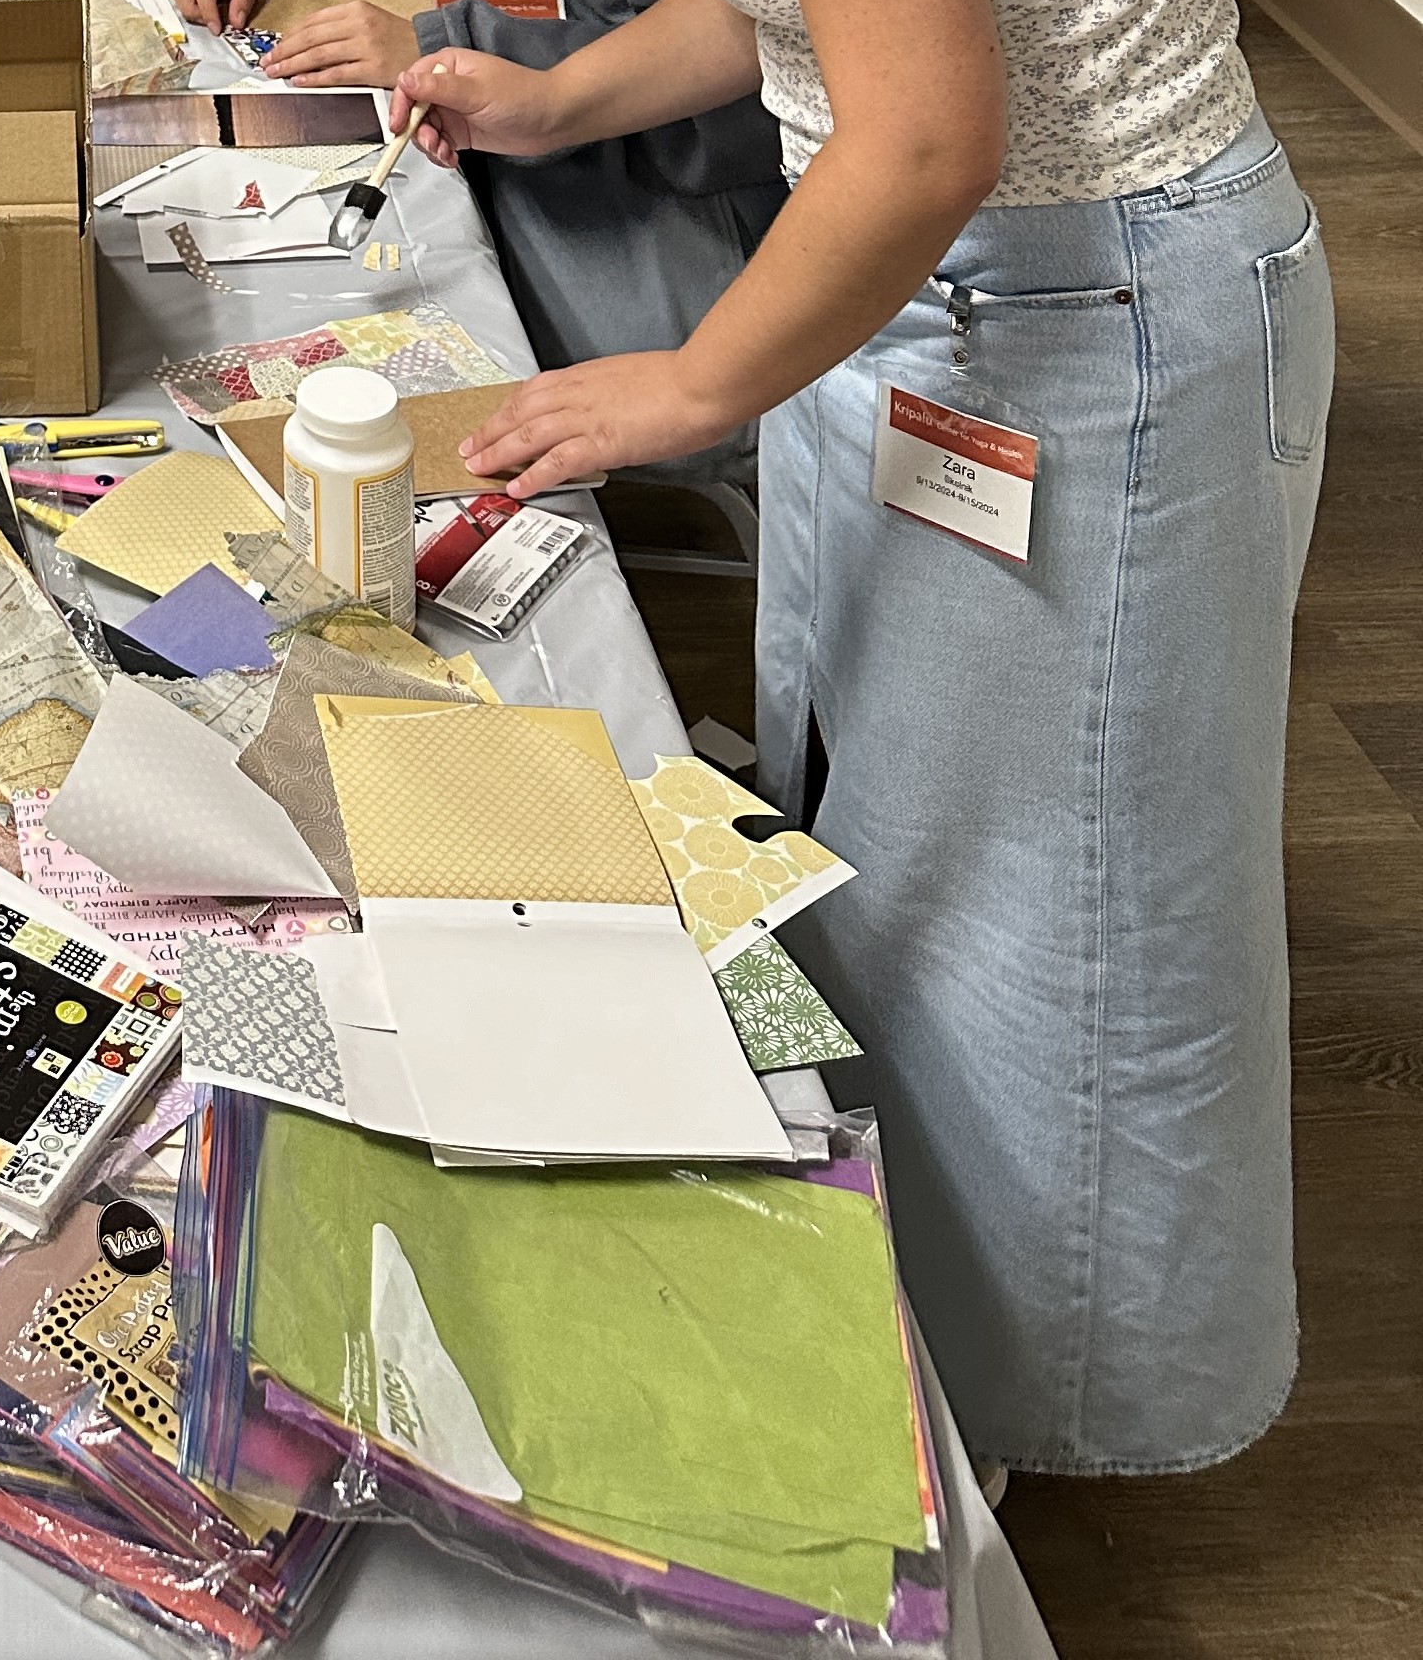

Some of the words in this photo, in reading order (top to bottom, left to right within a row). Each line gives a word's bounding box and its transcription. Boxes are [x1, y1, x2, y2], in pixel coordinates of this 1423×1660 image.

[989, 443, 997, 452] &
[942, 454, 976, 481] Zara
[38, 886, 101, 899] birthday
[84, 899, 150, 908] BIRTHDAY
[134, 909, 176, 920] HAPPY
[210, 923, 276, 938] HAPPY
[9, 990, 36, 1013] the
[102, 1227, 162, 1259] Value
[118, 1324, 161, 1364] Scrap
